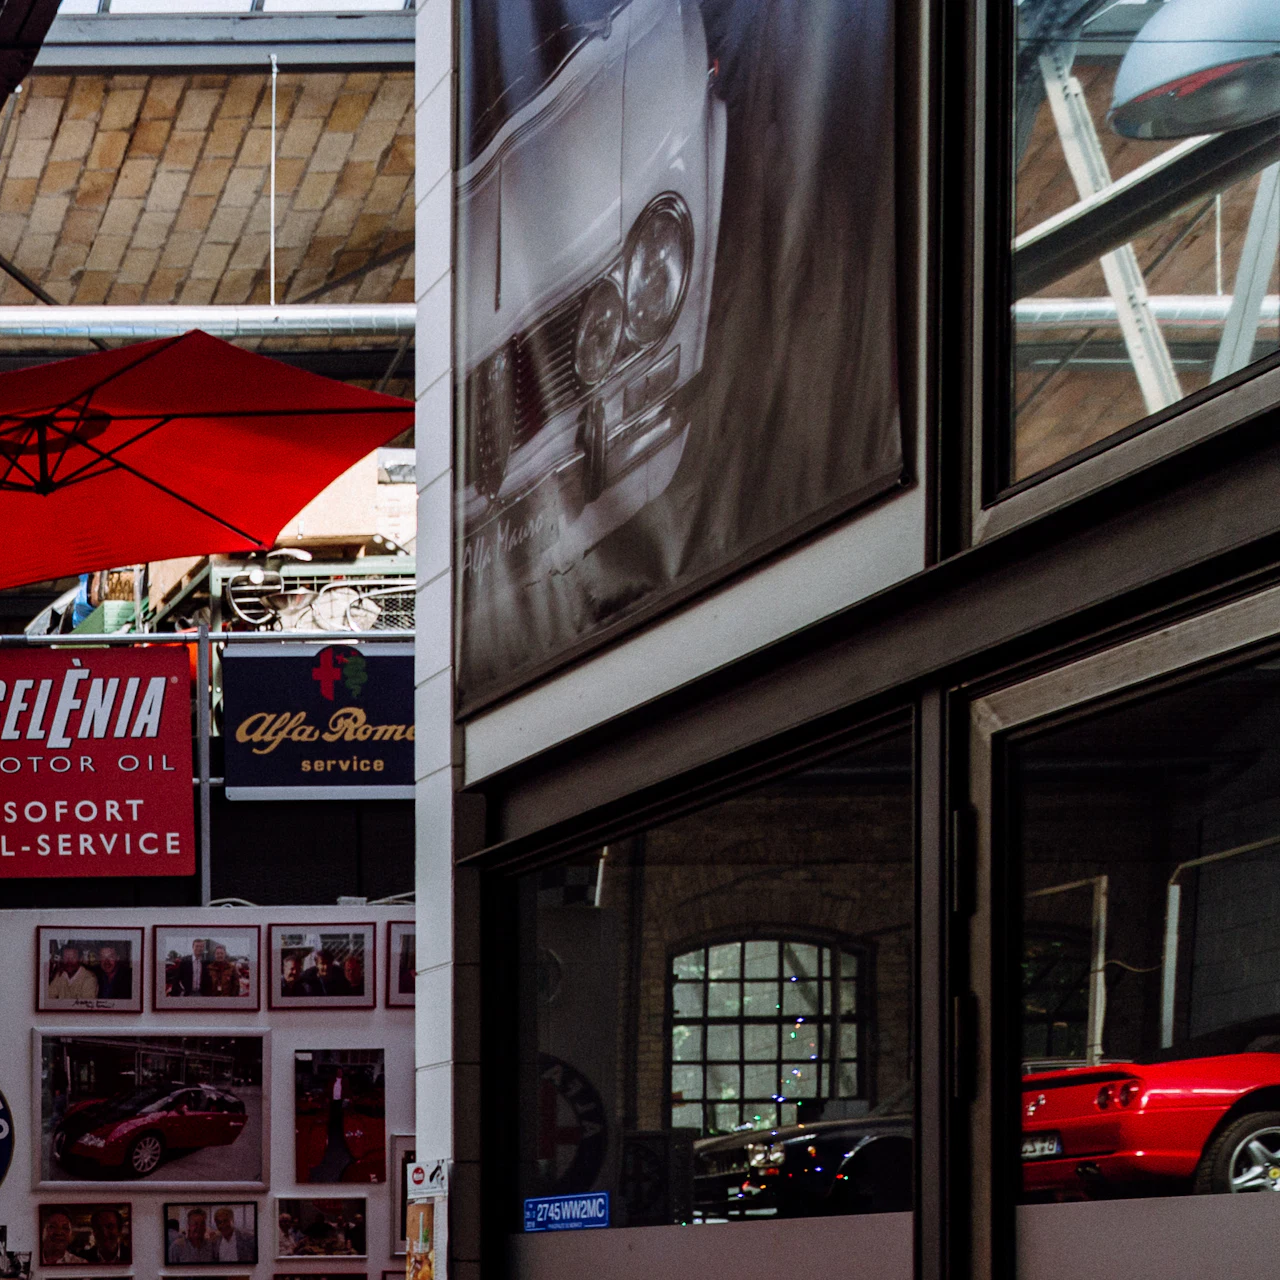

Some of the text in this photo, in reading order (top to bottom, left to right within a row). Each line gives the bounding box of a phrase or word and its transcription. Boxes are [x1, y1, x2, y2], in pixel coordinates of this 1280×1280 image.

[235, 706, 415, 755] Alfa Rome
[117, 754, 176, 772] OIL
[300, 756, 385, 773] service
[3, 800, 144, 823] SOFORT
[536, 1197, 605, 1222] 2745WW2MC
